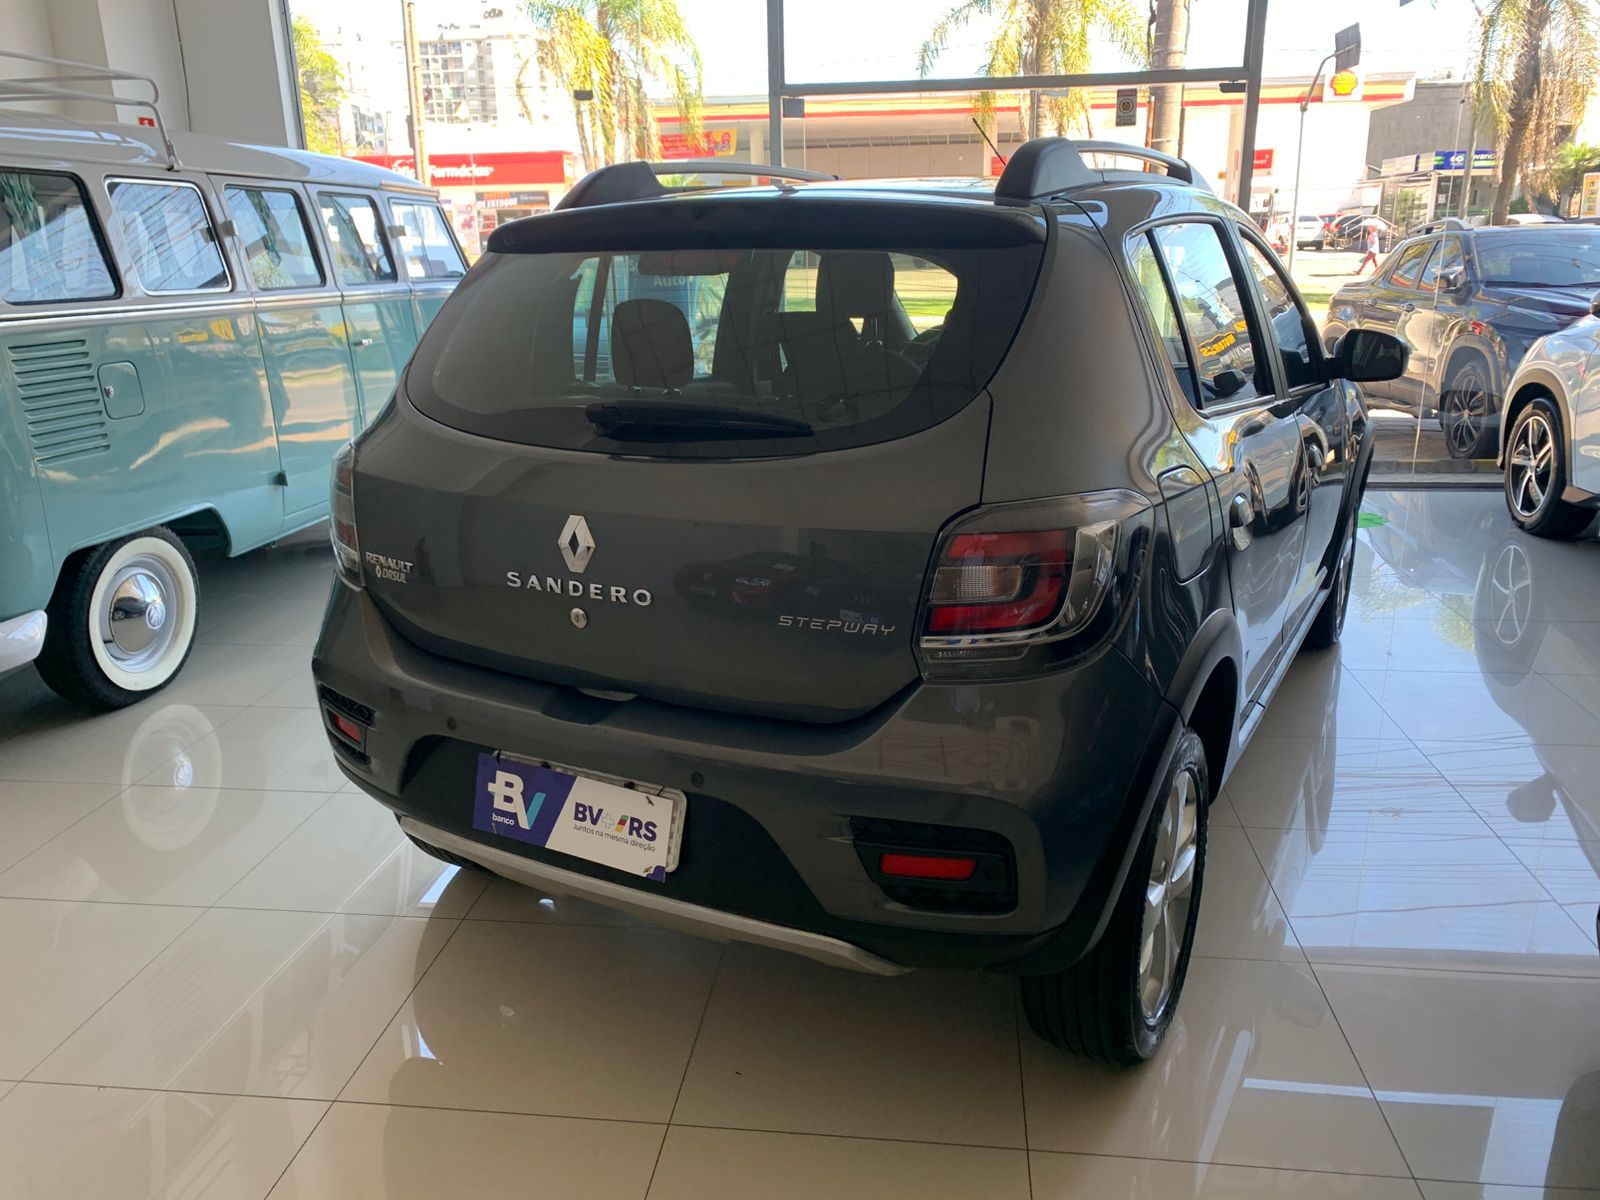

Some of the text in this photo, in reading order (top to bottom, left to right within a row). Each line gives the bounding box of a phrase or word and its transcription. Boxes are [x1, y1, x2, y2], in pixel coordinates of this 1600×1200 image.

[366, 551, 413, 573] RENAULT
[506, 571, 652, 606] SANDERO
[778, 615, 895, 636] STEPWAY
[491, 812, 515, 827] banco
[572, 823, 656, 853] Juntos na mesma direção
